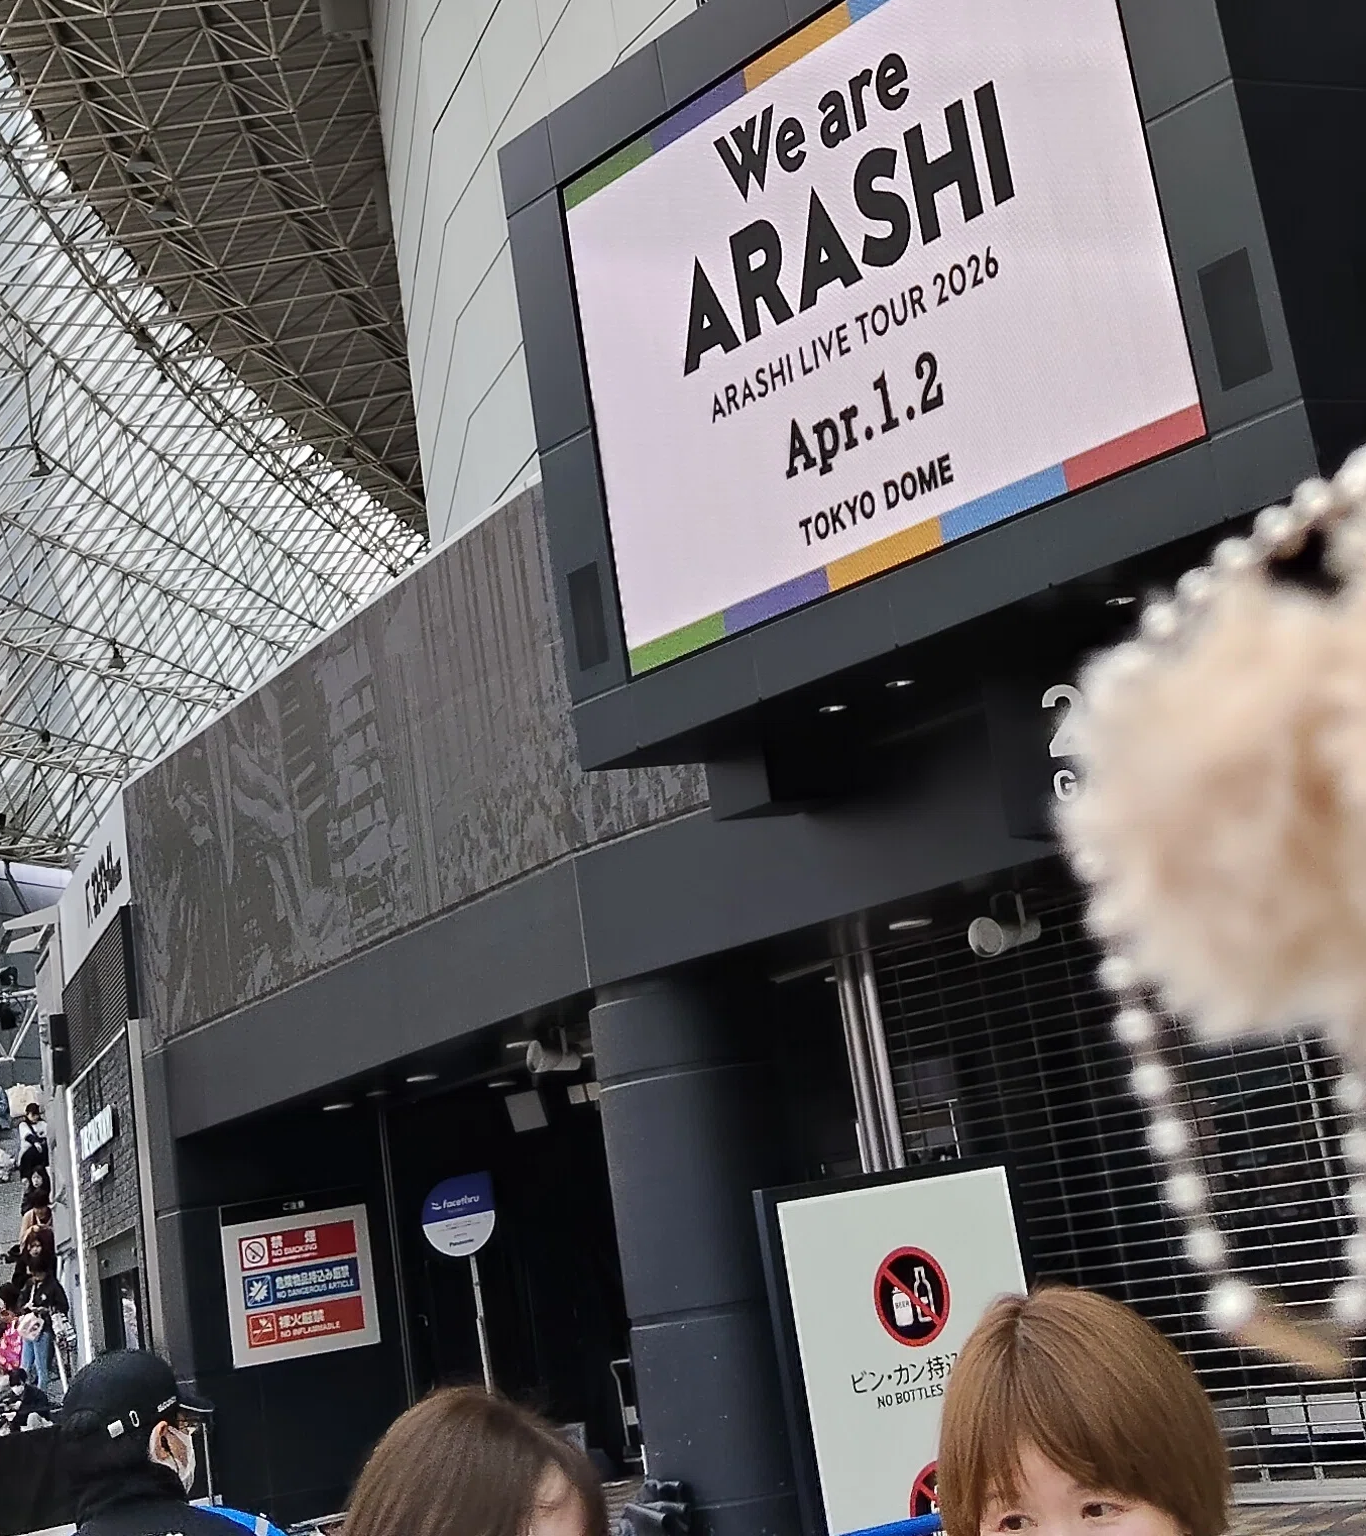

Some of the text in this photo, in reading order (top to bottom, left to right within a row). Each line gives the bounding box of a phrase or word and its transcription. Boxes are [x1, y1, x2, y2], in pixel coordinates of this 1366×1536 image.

[713, 52, 910, 203] We are
[684, 80, 1015, 377] ARASHI
[712, 245, 999, 423] ARASHI LIVE TOUR 2026
[799, 453, 954, 546] TOKYO DOME
[442, 1195, 480, 1209] facethru
[271, 1243, 318, 1257] NO SMOKING
[276, 1290, 287, 1299] NO
[280, 1329, 292, 1338] NO
[877, 1383, 944, 1409] NO BOTTLES
